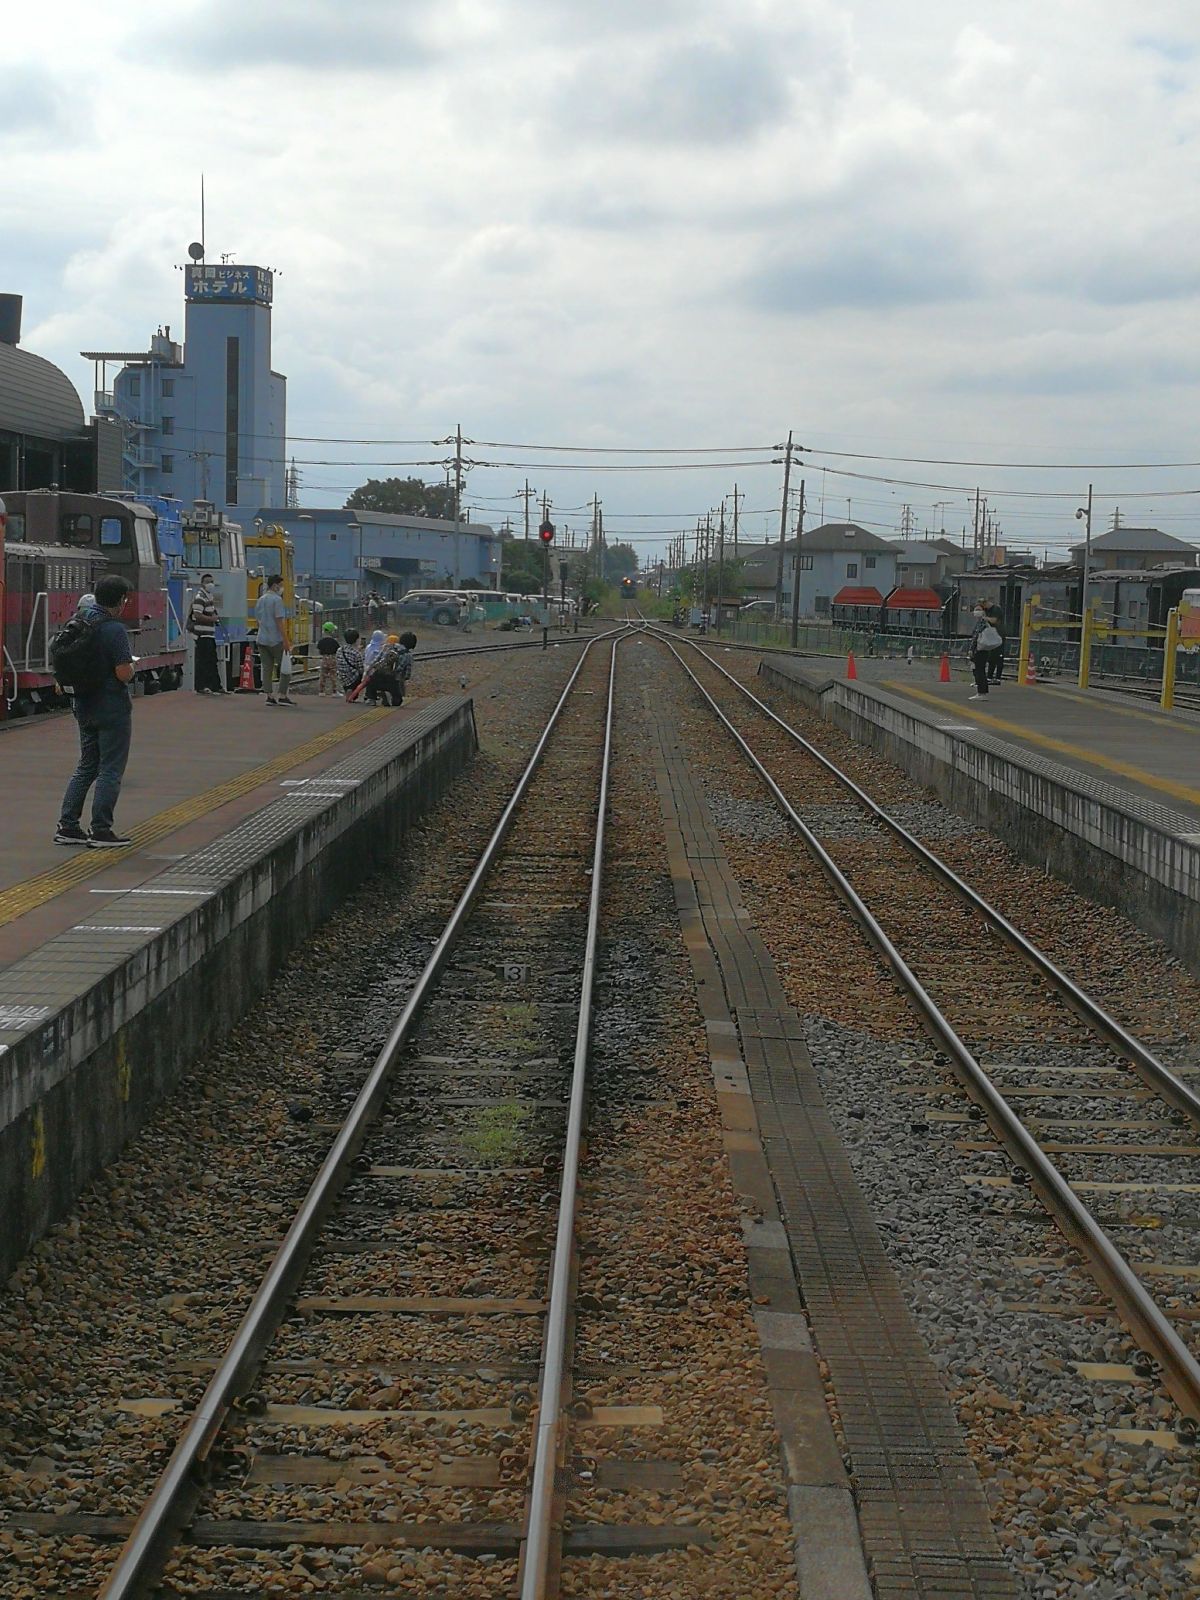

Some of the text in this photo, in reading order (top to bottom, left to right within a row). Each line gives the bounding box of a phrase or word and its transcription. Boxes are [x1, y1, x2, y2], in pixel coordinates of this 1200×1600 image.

[193, 280, 248, 293] ホテル
[508, 966, 521, 981] 3
